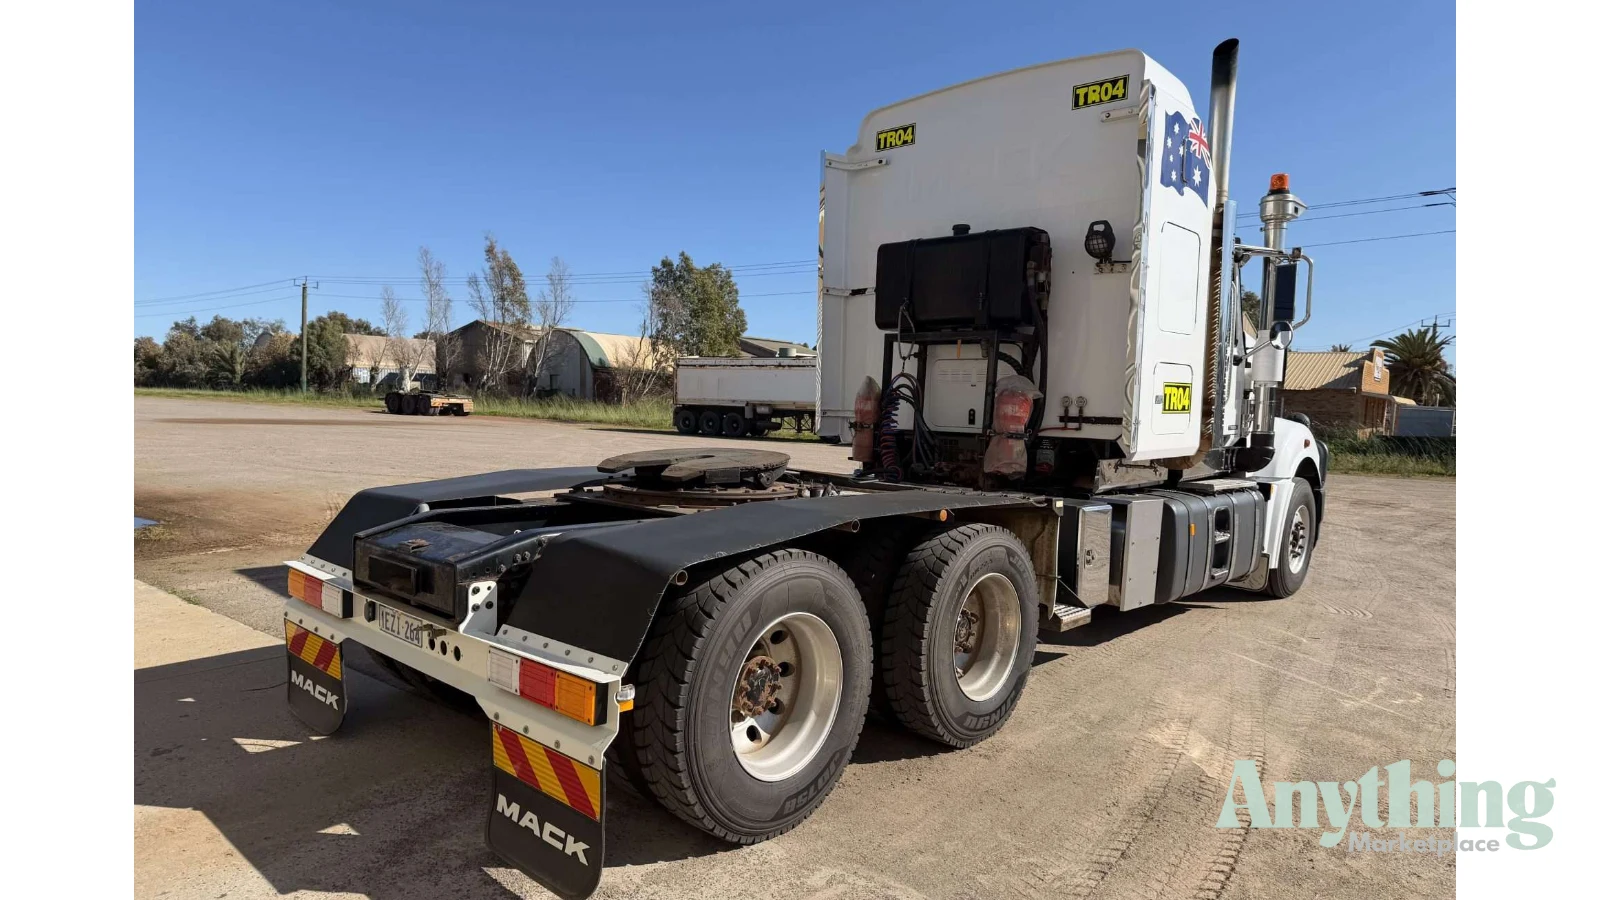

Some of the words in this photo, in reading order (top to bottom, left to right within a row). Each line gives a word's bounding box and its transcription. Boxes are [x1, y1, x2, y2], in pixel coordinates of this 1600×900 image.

[1076, 79, 1125, 106] TR04
[879, 126, 913, 149] TR04
[1164, 386, 1190, 411] TR04
[291, 669, 340, 711] MACK
[496, 793, 591, 866] MACK
